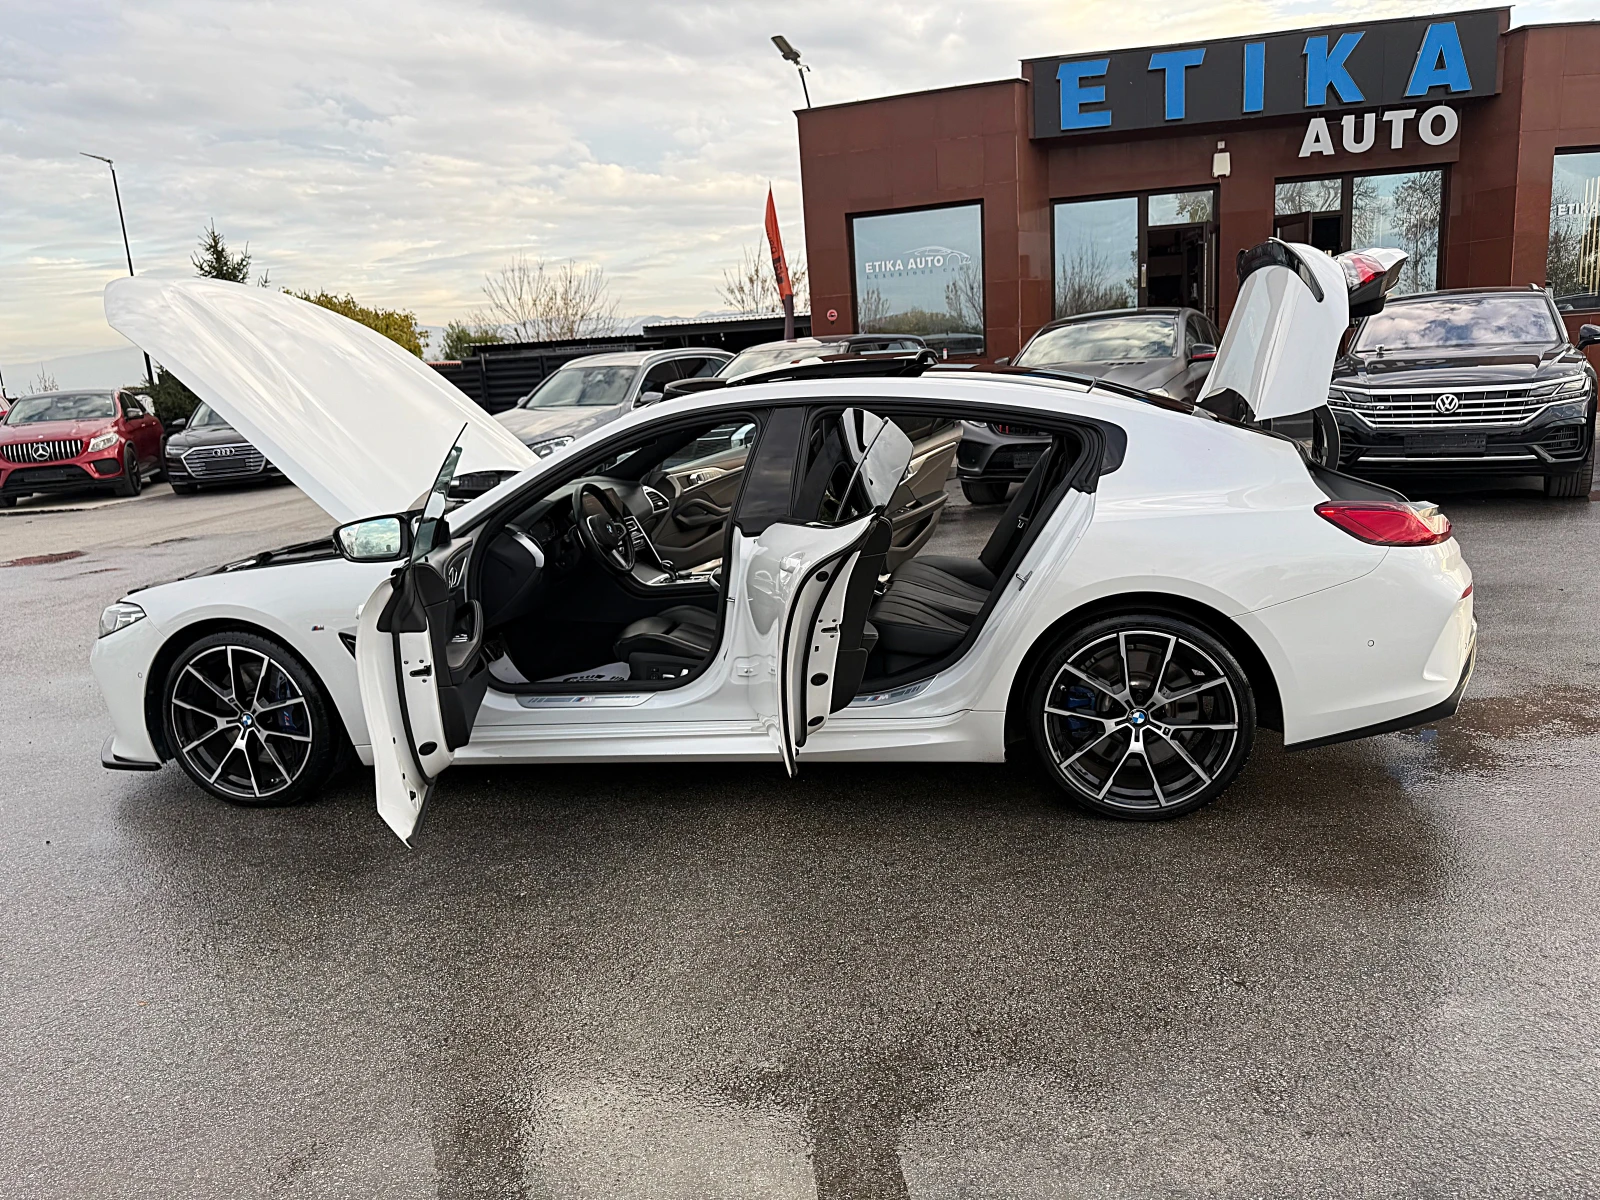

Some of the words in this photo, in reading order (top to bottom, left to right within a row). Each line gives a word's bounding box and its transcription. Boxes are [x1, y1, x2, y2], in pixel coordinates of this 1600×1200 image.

[1056, 21, 1472, 131] ETIKA
[1298, 105, 1459, 157] AUTO
[1558, 202, 1599, 216] ETIKA
[865, 259, 904, 273] ETIKA
[907, 255, 944, 270] AUTO
